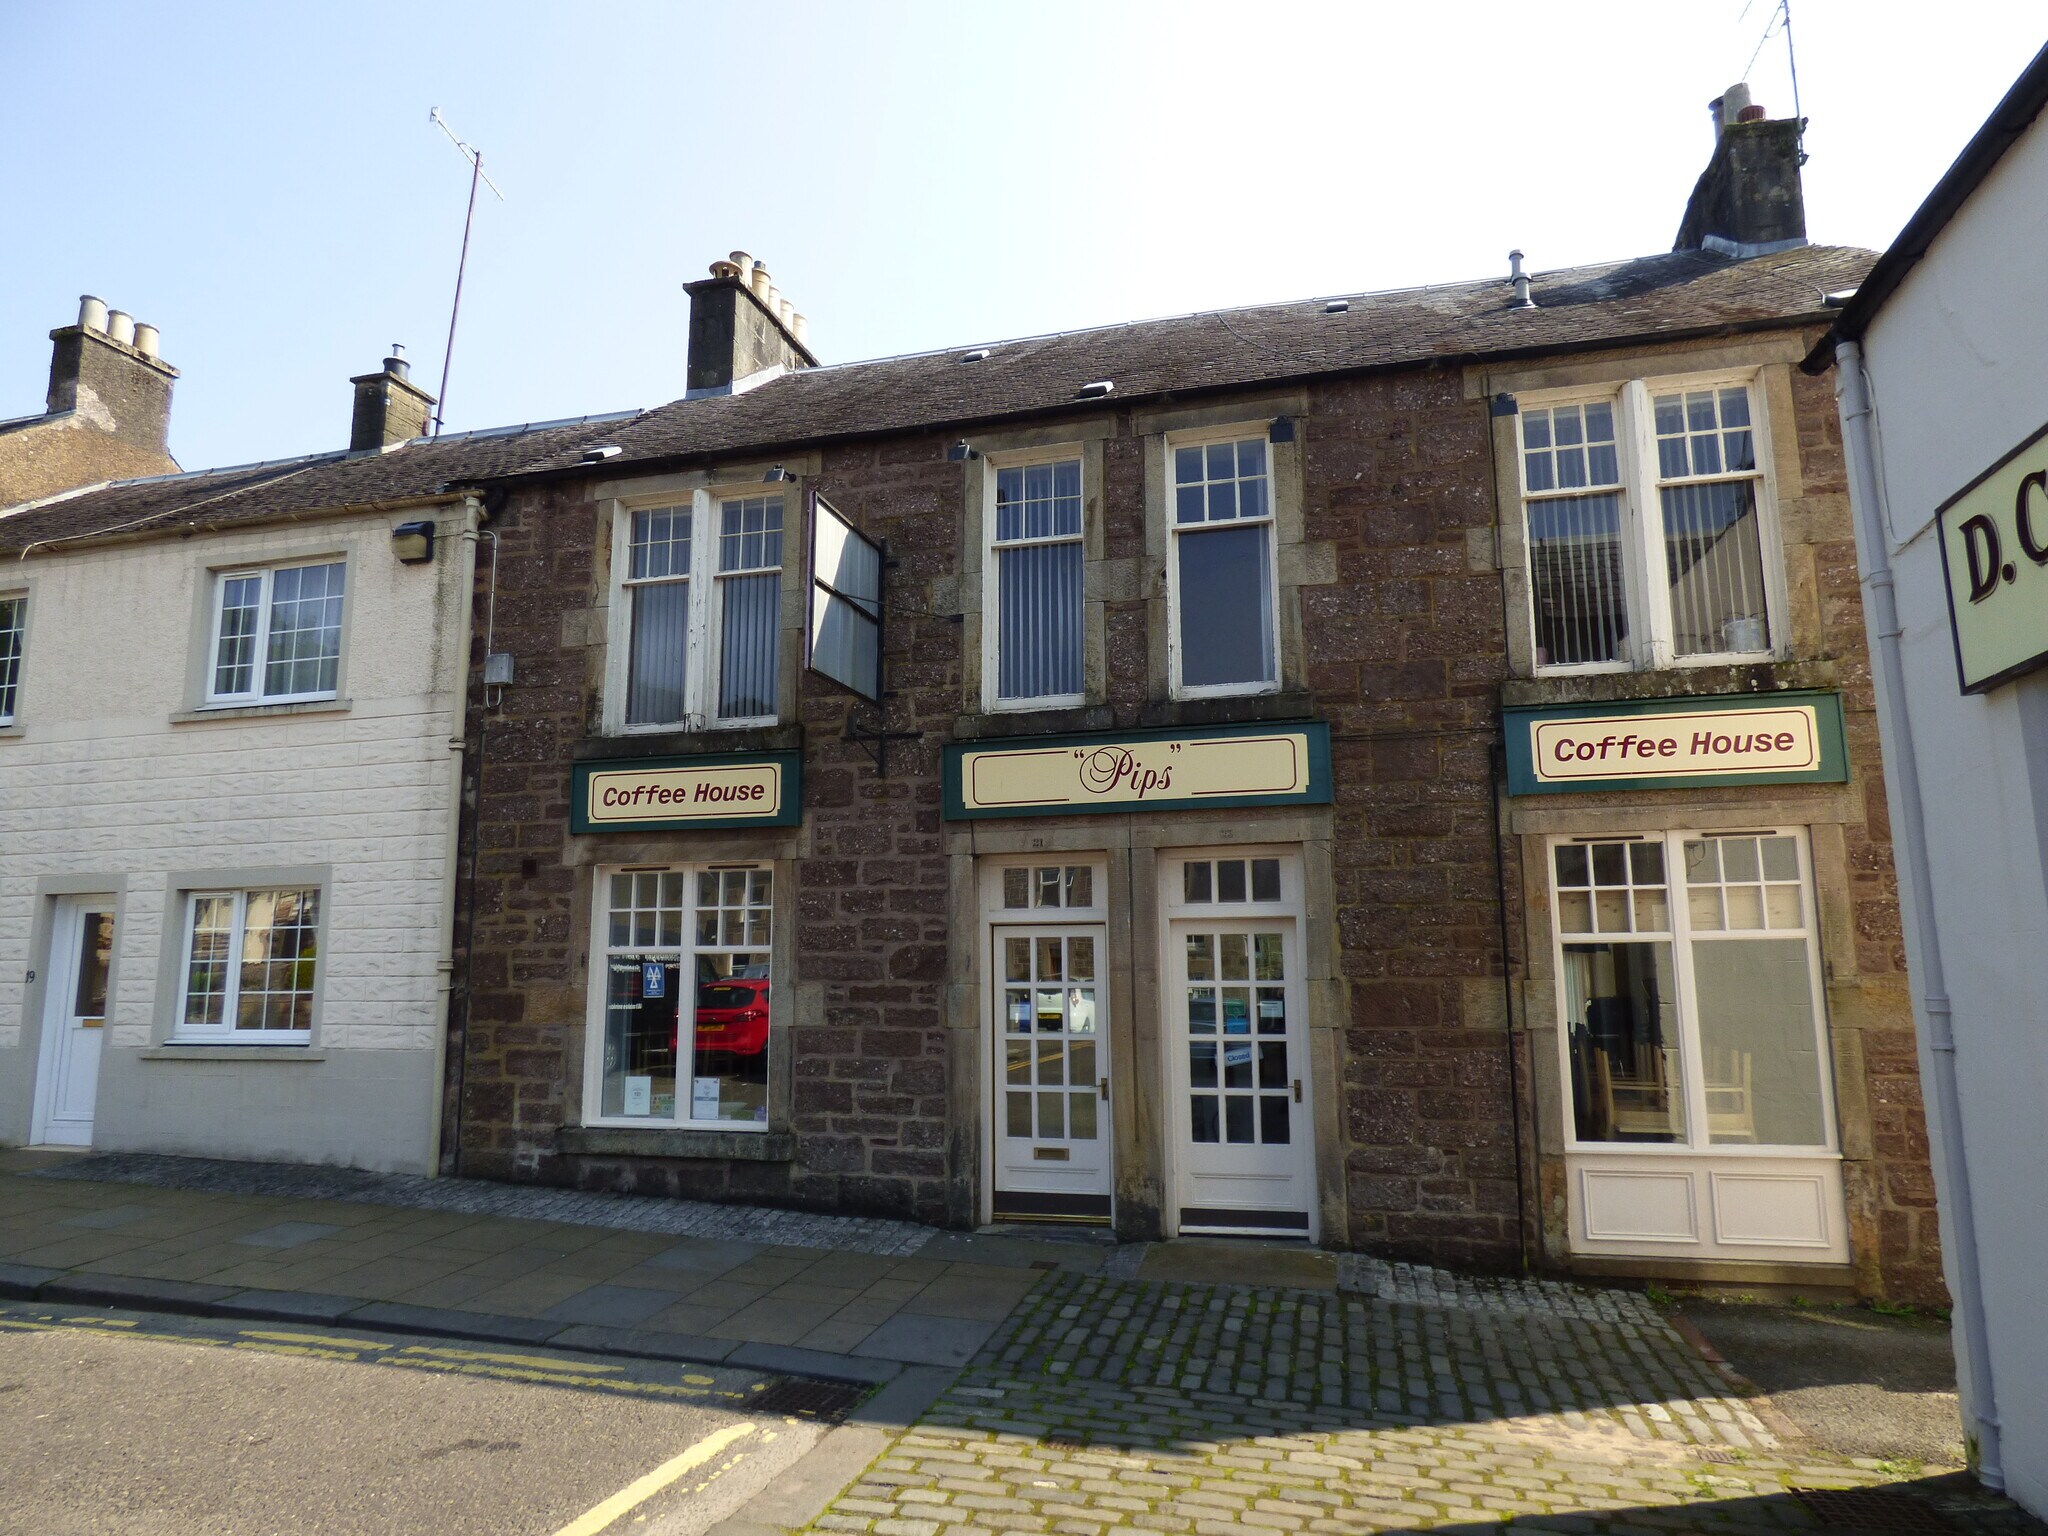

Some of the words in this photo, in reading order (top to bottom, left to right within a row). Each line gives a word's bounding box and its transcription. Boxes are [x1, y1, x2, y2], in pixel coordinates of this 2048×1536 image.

[1554, 734, 1678, 762] Coffee
[1689, 731, 1795, 756] House
[602, 785, 686, 807] Coffee
[693, 783, 765, 803] House
[1032, 838, 1044, 848] 21
[25, 969, 36, 984] 19
[1227, 1050, 1250, 1062] Closed
